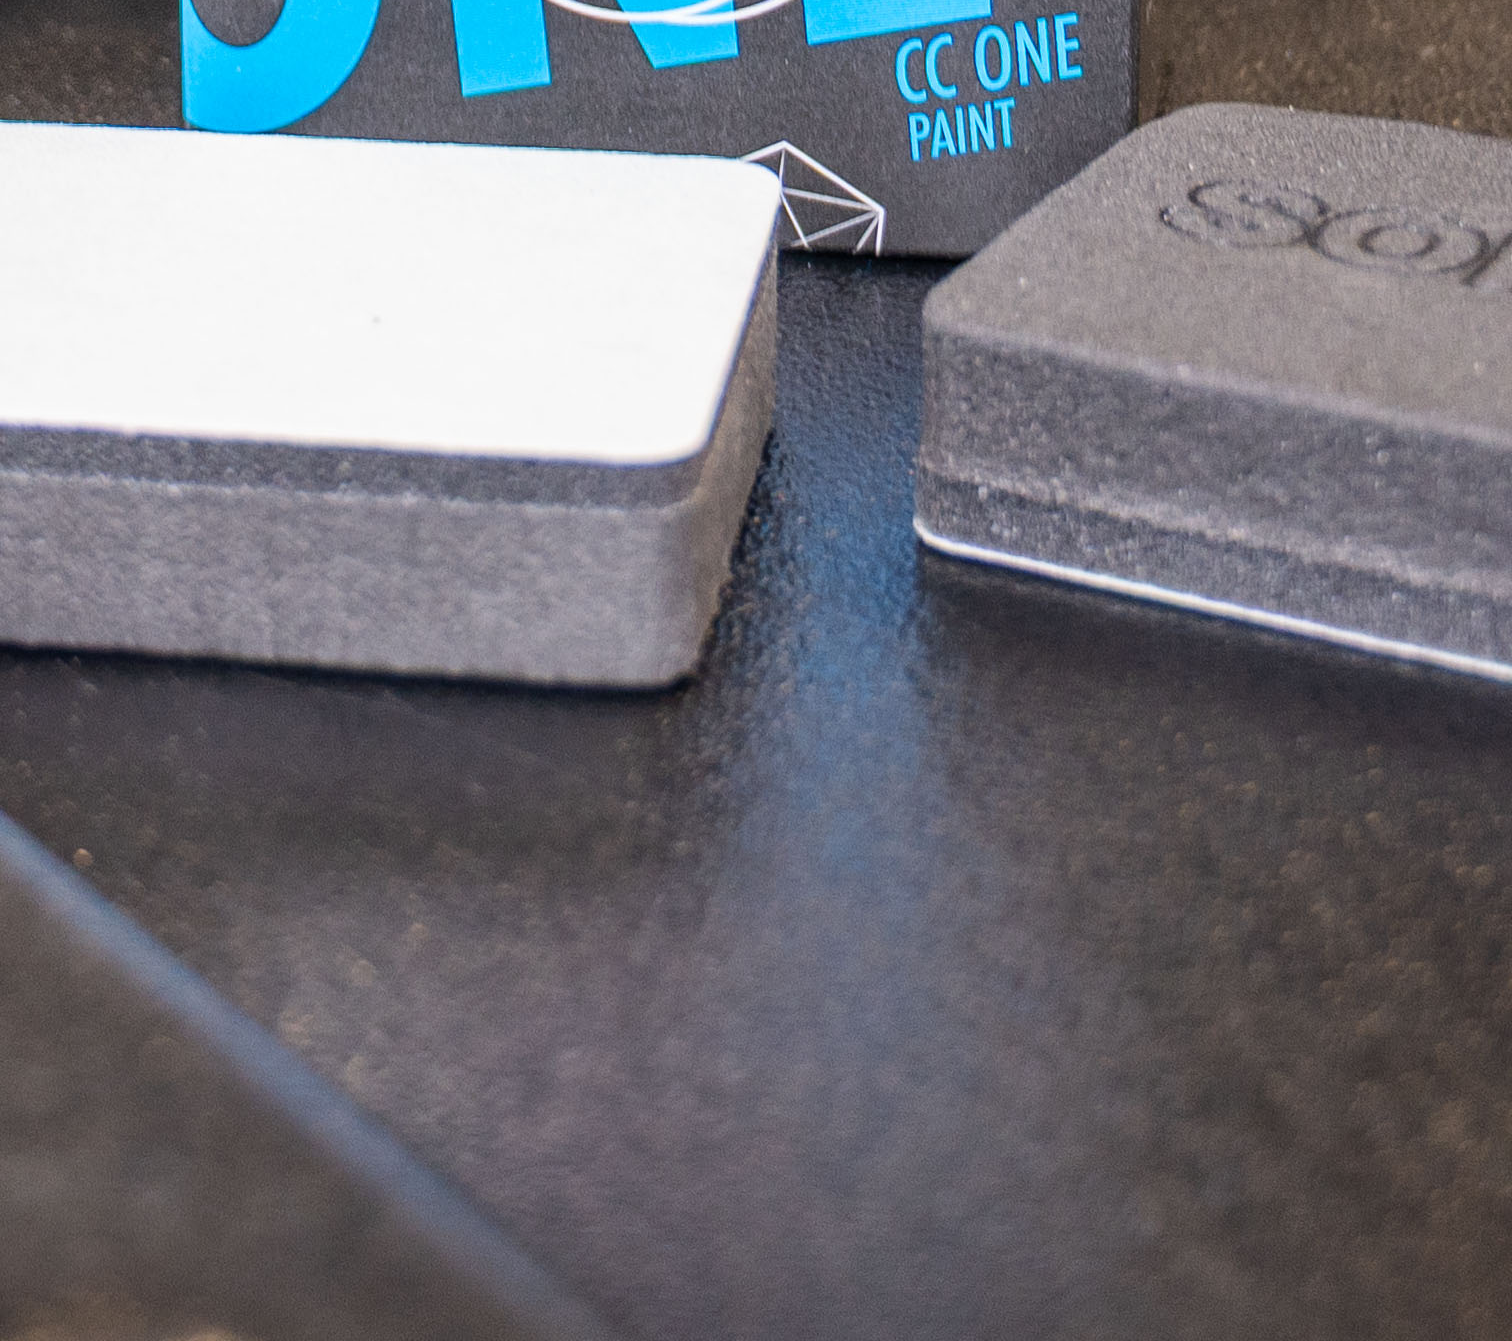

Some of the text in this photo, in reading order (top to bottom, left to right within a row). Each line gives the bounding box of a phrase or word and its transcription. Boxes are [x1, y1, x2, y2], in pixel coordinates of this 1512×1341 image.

[895, 12, 1084, 105] CC ONE
[908, 96, 1017, 162] PAINT
